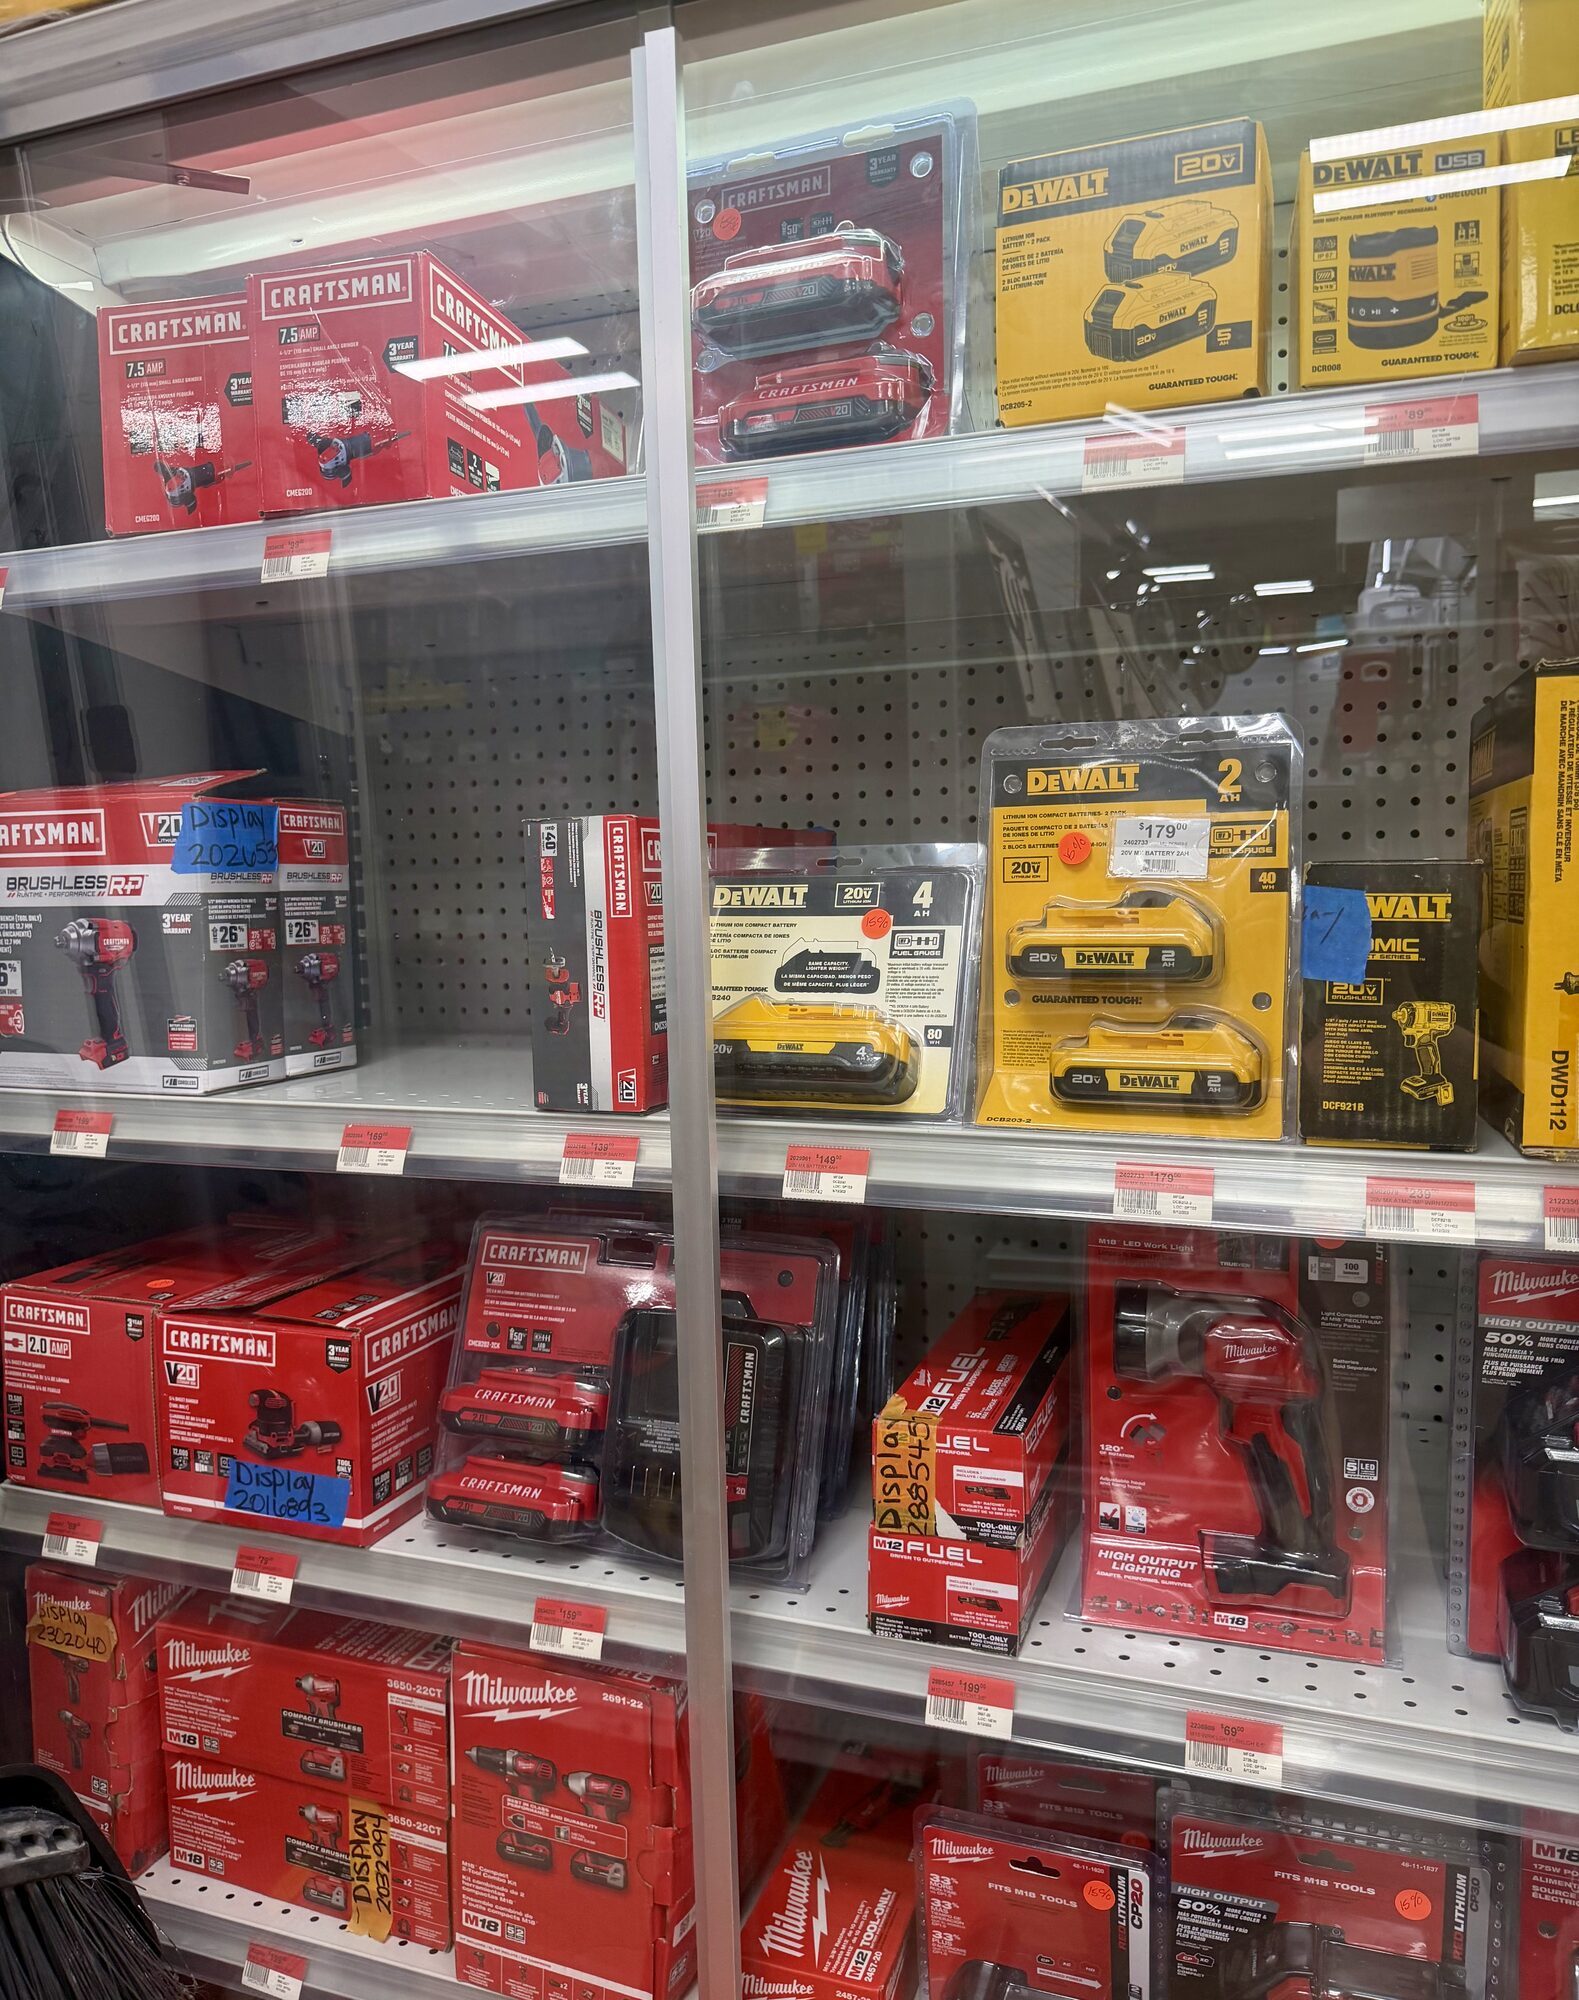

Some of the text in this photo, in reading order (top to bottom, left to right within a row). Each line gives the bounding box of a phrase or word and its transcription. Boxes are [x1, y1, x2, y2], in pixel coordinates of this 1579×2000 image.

[869, 154, 896, 171] 3 YEAR
[869, 168, 896, 177] WARRANTY
[1313, 153, 1482, 185] DEWALT USB
[728, 175, 823, 209] CRAFTSMAN
[1003, 171, 1108, 212] DEWALT
[1002, 233, 1024, 243] LITHIUM
[271, 272, 400, 309] CRAFTSMAN
[118, 311, 241, 344] CRAFTSMAN
[280, 327, 318, 344] 7.5 AMP
[1217, 328, 1231, 341] 5
[388, 341, 414, 356] 3 YEAR
[127, 359, 164, 377] 7.5 AMP
[1312, 363, 1341, 373] DCR008
[758, 377, 859, 399] CRAFTSMAN
[1000, 401, 1032, 411] DCB205-2
[1560, 700, 1567, 712] DE
[1559, 713, 1567, 747] MARCHE
[1558, 749, 1566, 769] AVEC
[1027, 767, 1139, 792] DEWALT
[1218, 758, 1243, 794] 2
[1219, 794, 1240, 802] AH
[190, 804, 265, 840] Display
[1556, 848, 1562, 859] EN
[1259, 872, 1276, 885] 40
[713, 886, 808, 906] DEWALT
[912, 881, 933, 908] 4
[1368, 896, 1448, 919] WALT
[219, 925, 245, 943] 26%
[594, 910, 605, 991] BRUSHLESS
[1029, 950, 1175, 965] 20V DEWALT 2
[1032, 995, 1099, 1004] GUARANTEED
[927, 1029, 942, 1040] 80
[1549, 1050, 1569, 1131] DWD112
[1323, 1101, 1364, 1112] DCF921B
[489, 1244, 581, 1266] CRAFTSMAN
[1123, 1240, 1141, 1248] LED
[1143, 1241, 1167, 1250] Work
[1170, 1243, 1194, 1253] Light
[1343, 1262, 1359, 1271] 100
[9, 1303, 84, 1326] CRAFTSMAN
[30, 1336, 69, 1355] 2.0 AMP
[170, 1330, 268, 1357] CRAFTSMAN
[1484, 1331, 1534, 1347] 50%
[328, 1345, 350, 1355] 3 YEAR
[1224, 1343, 1278, 1359] Milwaukee
[1483, 1351, 1534, 1361] FUNCIONAMIENTO
[167, 1362, 196, 1384] V20
[1491, 1366, 1544, 1375] FONCTIONNEMENT
[369, 1373, 399, 1413] V20
[739, 1351, 755, 1425] CRAFTSMAN
[474, 1388, 556, 1409] CRAFTSMAN
[877, 1418, 908, 1529] Display
[1346, 1461, 1376, 1472] 5 LED
[237, 1460, 315, 1497] Display
[460, 1476, 543, 1500] CRAFTSMAN
[234, 1489, 330, 1522] 2016893
[875, 1539, 983, 1564] M12 FUEL
[890, 1552, 912, 1561] DRIVEN
[922, 1558, 965, 1568] OUTPERFORM.
[1097, 1549, 1198, 1570] HIGH OUTPUT
[1111, 1561, 1181, 1579] LIGHTING
[1215, 1613, 1248, 1628] M18
[37, 1624, 106, 1654] 2302040
[876, 1630, 903, 1639] 2557-20
[968, 1631, 1008, 1643] TOOL-ONLY
[164, 1638, 251, 1670] Milwaukee
[458, 1670, 579, 1708] Milwaukee
[602, 1692, 644, 1709] 2691-22
[282, 1710, 362, 1733] COMPACT BRUSHLESS
[168, 1730, 198, 1746] M18
[170, 1760, 256, 1791] Milwaukee
[930, 1838, 995, 1856] Milwaukee
[1179, 1828, 1264, 1849] Milwaukee
[1087, 1885, 1112, 1901] 15%
[1274, 1870, 1376, 1896] FITS M18 TOOLS
[1532, 1885, 1577, 1899] SOURCE
[758, 1848, 813, 1958] Milwaukee
[988, 1882, 1078, 1908] FITS M18 TOOLS
[1177, 1886, 1266, 1909] HIGH OUTPUT
[1399, 1894, 1423, 1911] 15%
[861, 1887, 893, 1947] TOOL-ONLY
[1177, 1898, 1220, 1916] 50%
[1453, 1873, 1467, 1961] REDLITHIUM
[465, 1912, 499, 1932] M18
[864, 1950, 883, 1982] 2457-20
